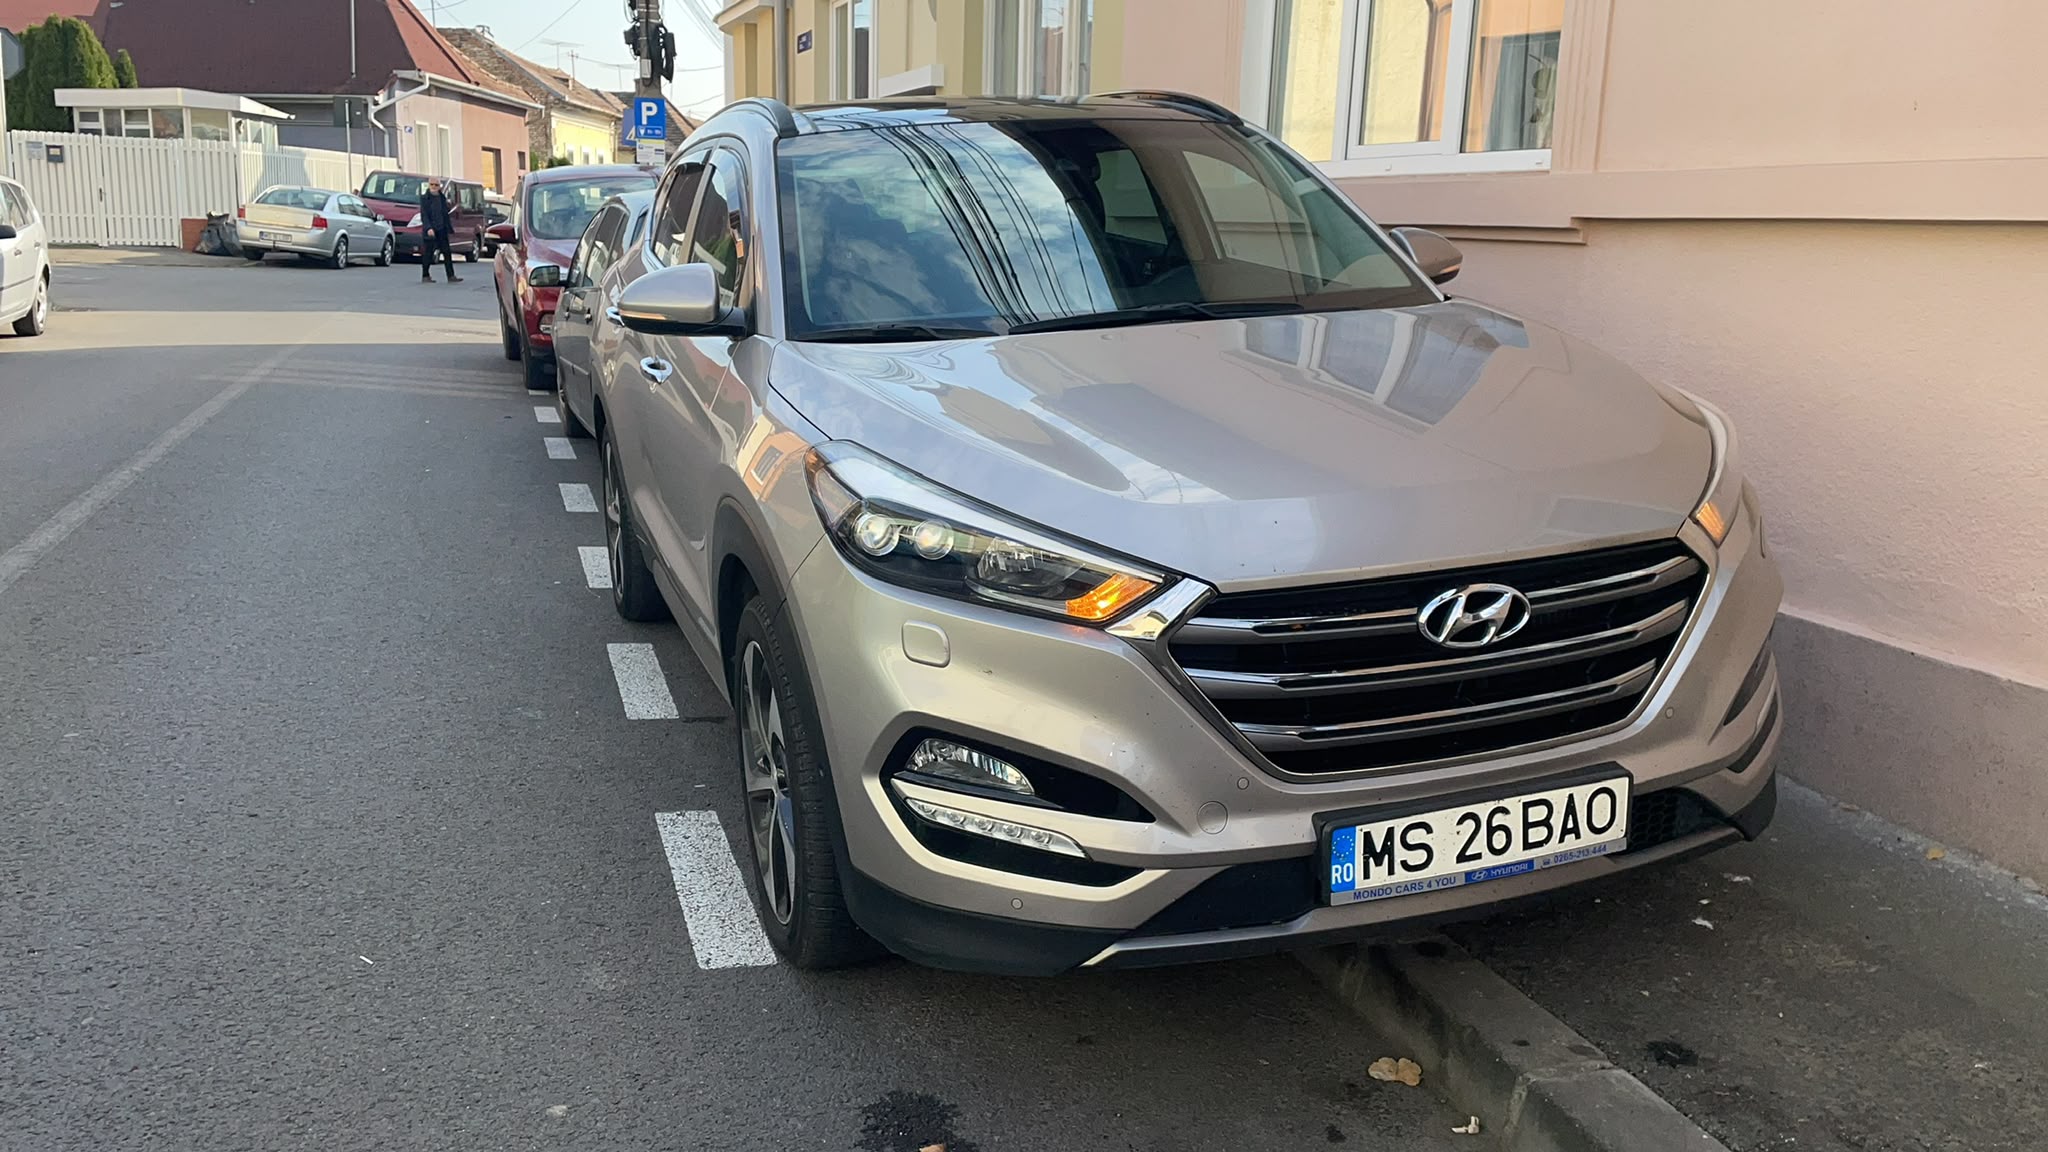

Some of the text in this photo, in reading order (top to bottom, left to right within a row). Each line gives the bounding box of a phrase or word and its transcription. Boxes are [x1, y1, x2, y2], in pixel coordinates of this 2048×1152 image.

[641, 102, 658, 125] P
[1363, 822, 1434, 880] MS
[1332, 862, 1354, 885] RO
[1490, 864, 1529, 877] HYUNDAI
[1353, 876, 1457, 900] MONDO CARS 4 YOU
